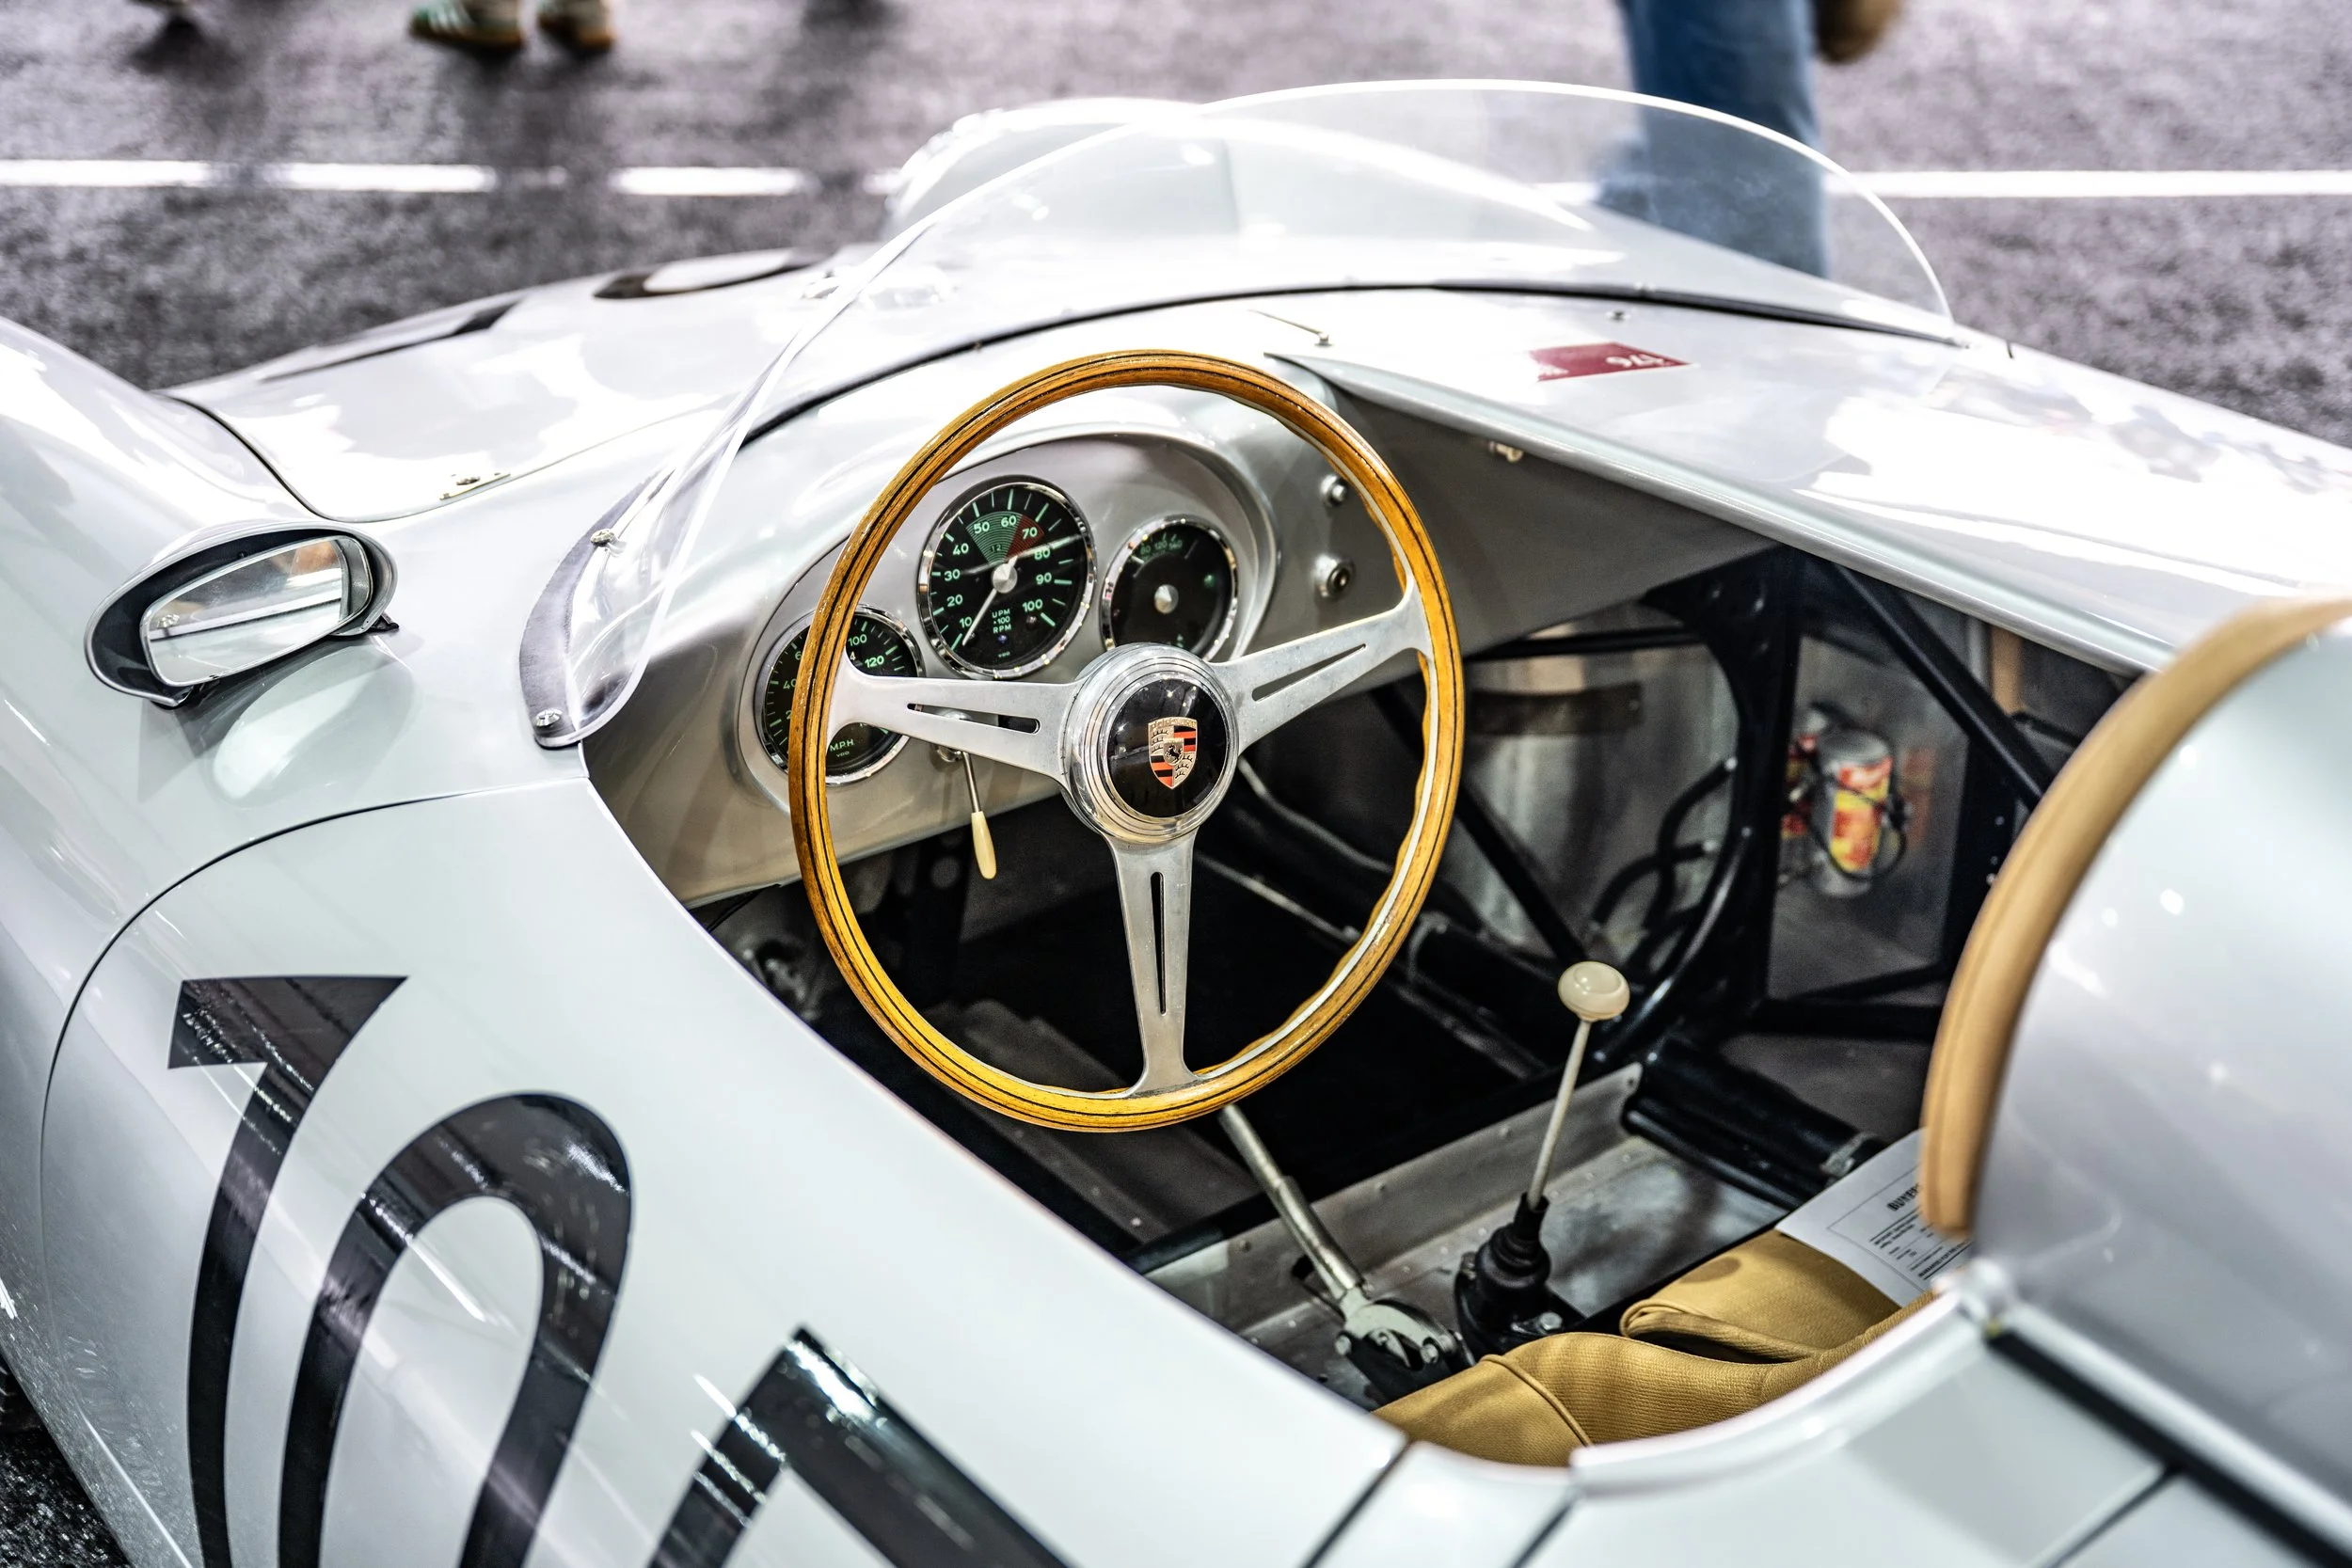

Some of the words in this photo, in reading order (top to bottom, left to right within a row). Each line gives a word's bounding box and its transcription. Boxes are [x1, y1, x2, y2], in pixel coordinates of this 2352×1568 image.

[973, 521, 990, 534] 50
[1000, 515, 1017, 528] 60
[1022, 527, 1038, 540] 70
[952, 543, 969, 555] 40
[1034, 547, 1051, 561] 80
[944, 569, 961, 581] 30
[1036, 572, 1052, 585] 90
[946, 594, 963, 608] 20
[1022, 599, 1043, 612] 100
[992, 608, 1010, 618] UPM
[959, 617, 973, 628] 10
[993, 624, 1011, 634] RPM
[848, 634, 867, 646] 100
[865, 656, 884, 668] 120
[830, 738, 854, 752] MPH
